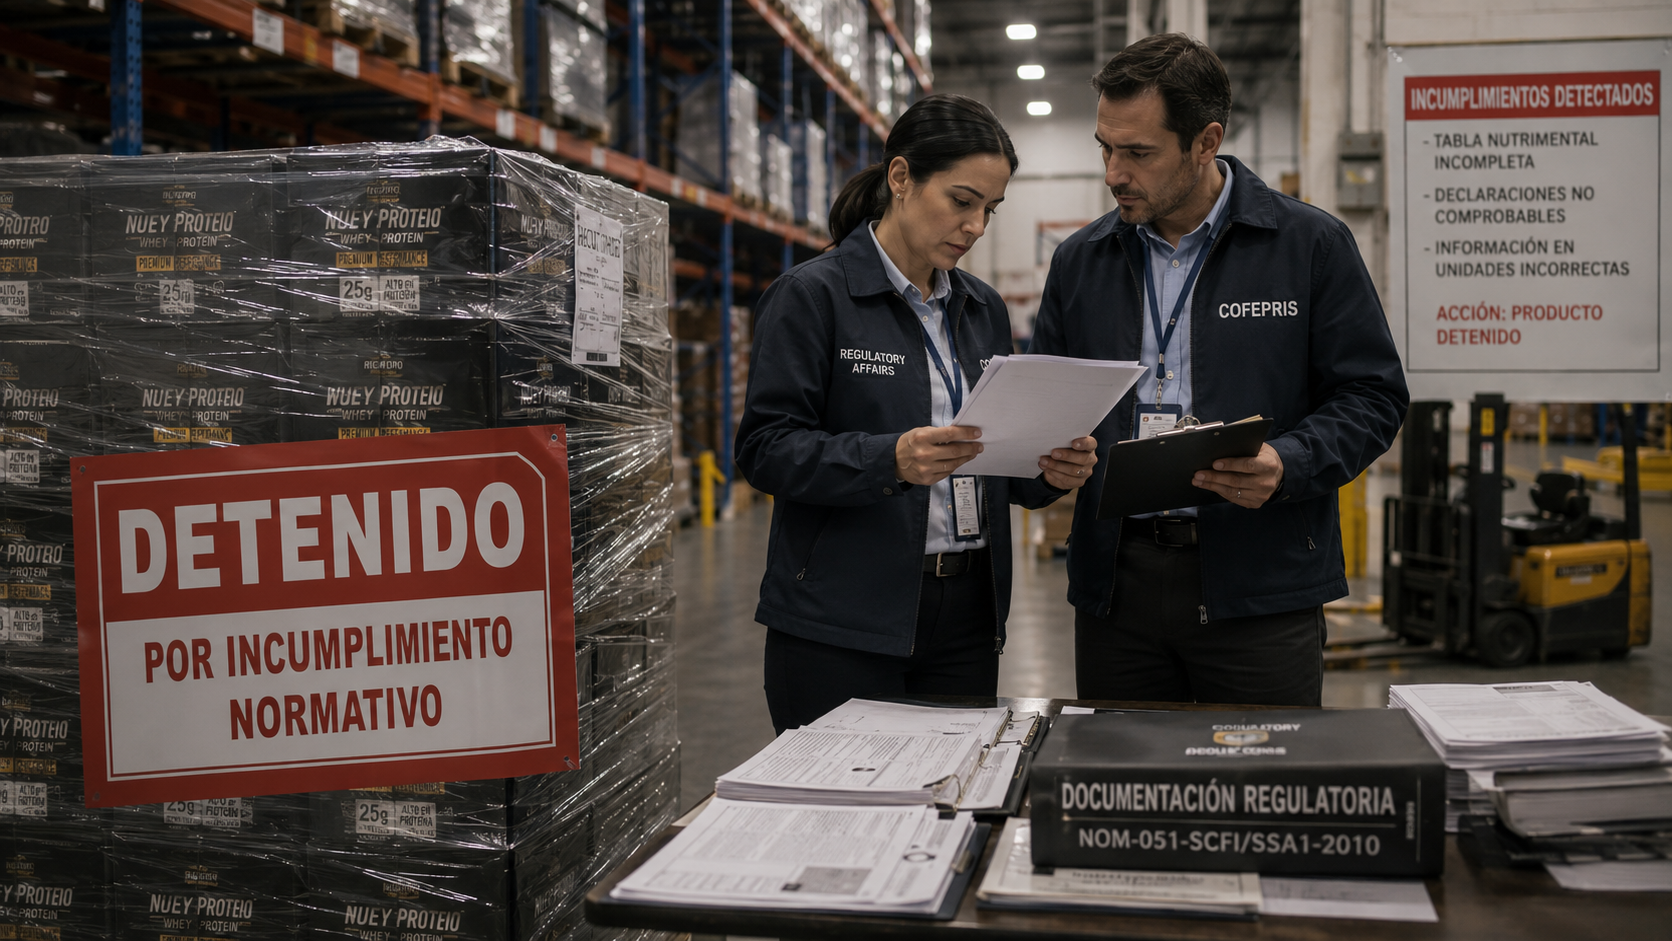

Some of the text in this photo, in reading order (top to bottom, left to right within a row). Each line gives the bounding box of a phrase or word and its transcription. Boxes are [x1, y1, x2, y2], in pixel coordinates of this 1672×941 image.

[1411, 82, 1654, 110] INCUMPLIMIENTOS DETECTADOS
[1434, 133, 1483, 148] TABLA
[1487, 131, 1599, 148] NUTRIMENTAL
[1434, 154, 1535, 170] INCOMPLETA
[1434, 186, 1567, 203] DECLARACIONES
[1571, 186, 1595, 202] NO
[1434, 208, 1566, 225] COMPROBABLES
[139, 236, 218, 249] WHEY PROTEIN
[340, 232, 424, 245] WHEY PROTEIN
[1435, 237, 1548, 256] INFORMACIÓN
[1553, 240, 1575, 255] EN
[1435, 262, 1630, 278] UNIDADES INCORRECTAS
[343, 280, 373, 302] 25g
[1218, 300, 1299, 319] COFEPRIS
[1436, 302, 1604, 322] ACCIÓN: PRODUCTO
[1436, 329, 1522, 345] DETENIDO
[840, 349, 906, 365] REGULATORY
[852, 363, 895, 375] AFFAIRS
[342, 409, 427, 421] WHEY PROTEIN
[117, 481, 526, 595] DETENIDO
[144, 615, 513, 684] POR INCUMPLIMIENTO
[229, 684, 443, 741] NORMATIVO
[1061, 778, 1396, 815] DOCUMENTACIÓN REGULATORIA
[359, 803, 389, 826] 25g
[1078, 828, 1381, 856] NOM-051-SCFI/SSA1-2010
[149, 893, 193, 915] NUEY
[163, 918, 193, 930] WHEY
[344, 905, 393, 927] NUEY
